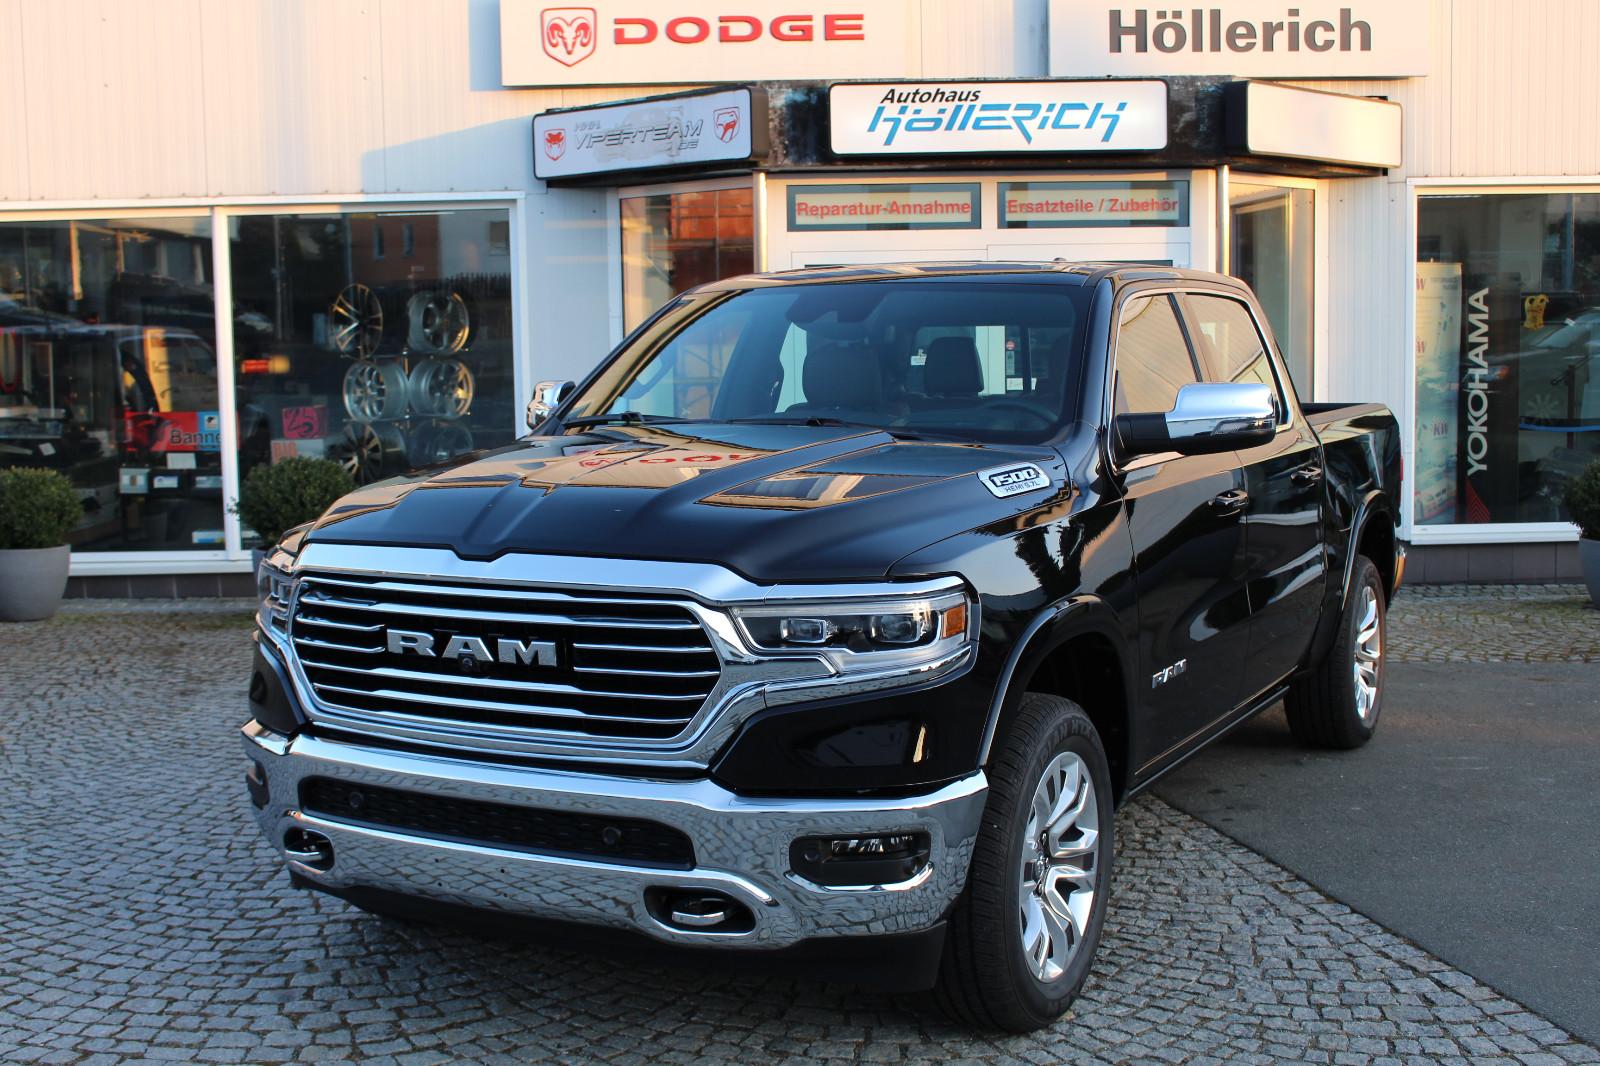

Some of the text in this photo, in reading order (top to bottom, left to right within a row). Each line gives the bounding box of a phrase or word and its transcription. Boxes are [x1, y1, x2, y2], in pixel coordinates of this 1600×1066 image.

[614, 14, 865, 44] DODGE
[1109, 8, 1371, 53] Höllerich
[880, 88, 981, 104] Autohaus
[796, 200, 971, 217] Reparatur-Annahme
[1007, 198, 1094, 214] Ersatzteile
[1108, 197, 1178, 214] Zubehör
[1467, 288, 1489, 477] YOKOHAMA
[169, 429, 221, 445] Banne
[990, 468, 1038, 487] 1500
[1005, 484, 1025, 492] HEMI
[386, 628, 557, 667] RAM
